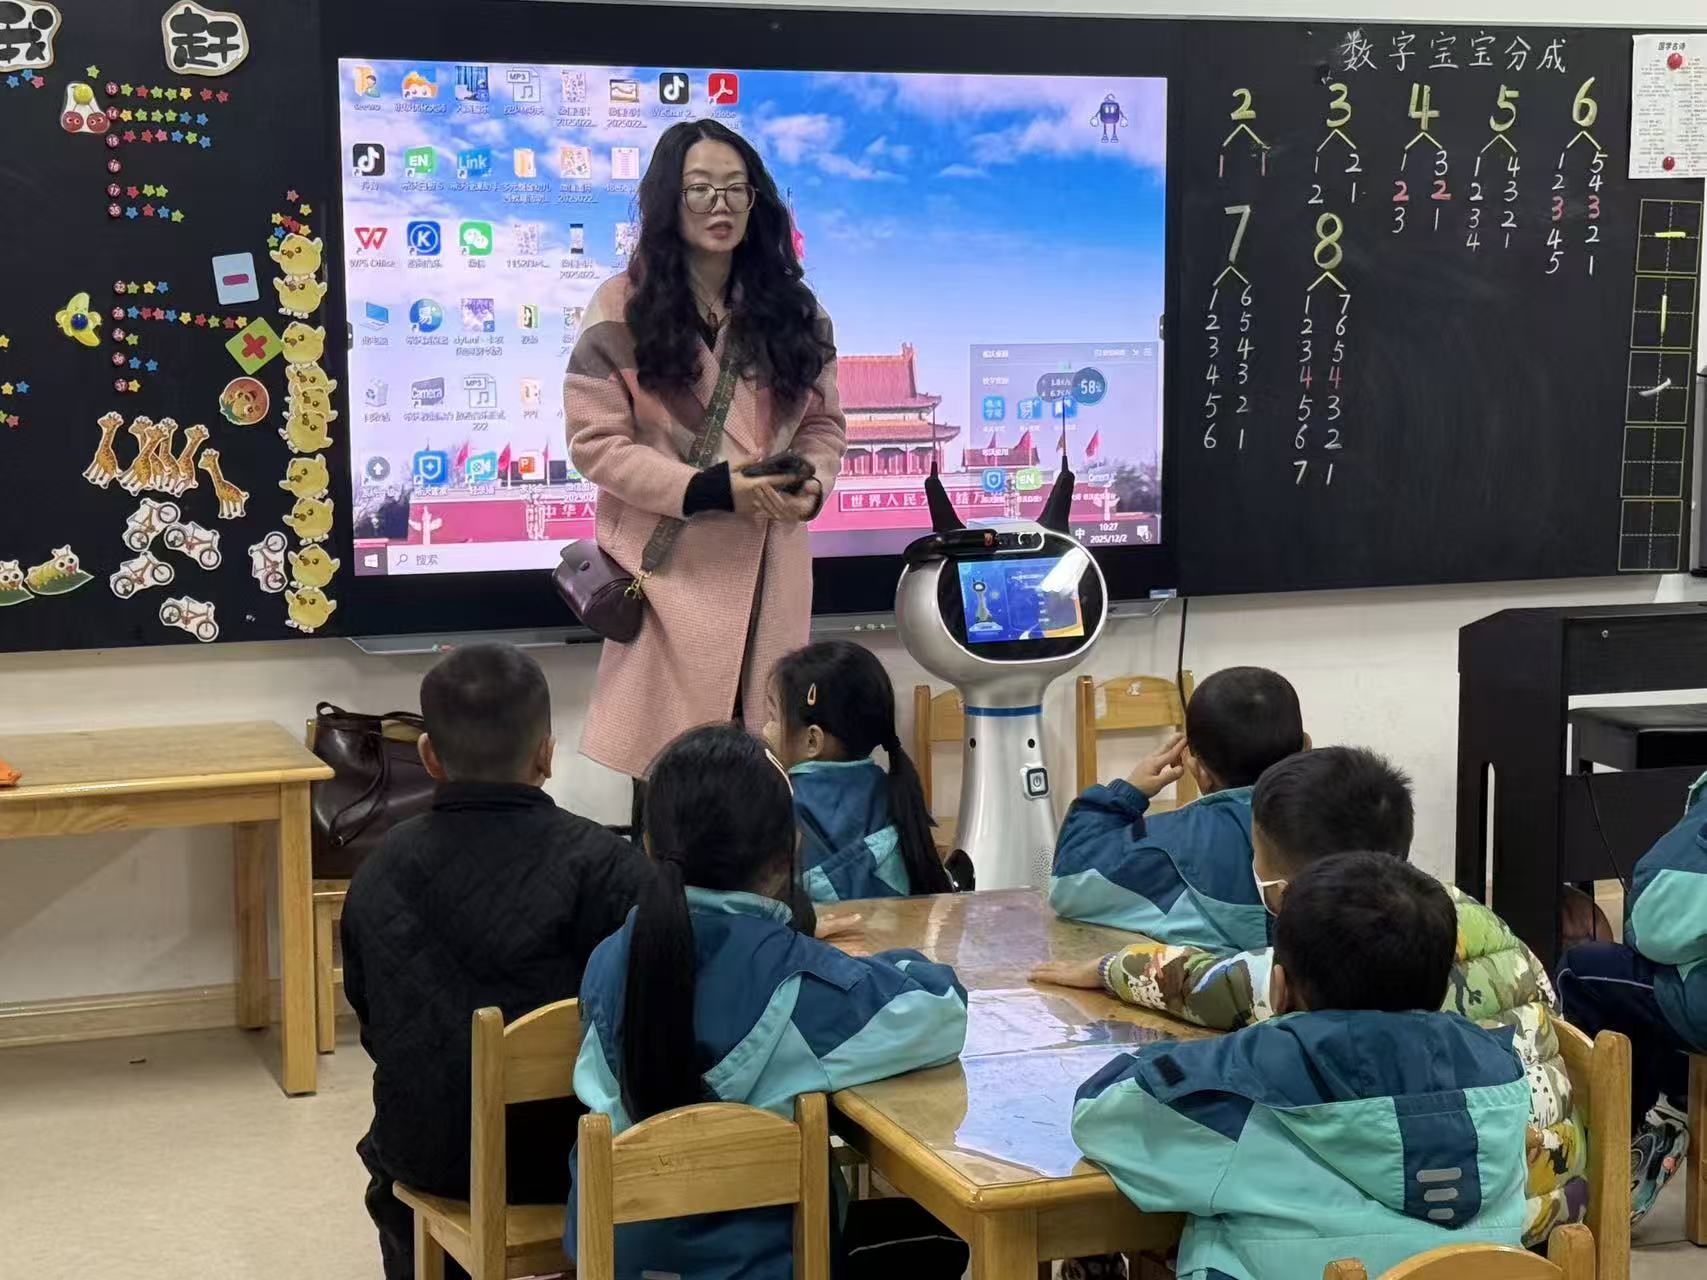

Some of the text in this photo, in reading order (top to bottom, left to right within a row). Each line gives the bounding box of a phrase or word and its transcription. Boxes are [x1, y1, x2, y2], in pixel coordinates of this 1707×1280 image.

[1339, 28, 1568, 75] 数字宝宝分成
[1230, 87, 1257, 121] 2
[1326, 82, 1352, 128] 3
[1407, 82, 1440, 131] 4
[1489, 83, 1520, 132] 5
[1572, 76, 1598, 127] 6
[409, 154, 429, 167] EN
[458, 154, 487, 169] Link
[1344, 153, 1363, 173] 2
[1434, 149, 1449, 177] 3
[1507, 155, 1521, 178] 4
[1589, 150, 1609, 174] 5
[1307, 183, 1325, 205] 2
[1392, 179, 1452, 202] 2 2
[1469, 180, 1519, 202] 2 3
[1551, 173, 1604, 193] 2 4
[1468, 207, 1518, 229] 3 2
[1551, 194, 1601, 221] 3 3
[1391, 206, 1406, 234] 3
[1224, 204, 1251, 263] 7
[1313, 212, 1343, 270] 8
[1465, 232, 1481, 252] 4
[1546, 225, 1601, 250] 4 2
[1545, 250, 1565, 275] 5
[1240, 284, 1252, 307] 6
[1338, 293, 1351, 315] 7
[1205, 311, 1252, 332] 2 5
[1300, 314, 1348, 336] 2 6
[1208, 336, 1254, 360] 3 4
[1299, 339, 1345, 363] 3 5
[1206, 362, 1249, 386] 4 3
[1299, 365, 1342, 390] 4 4
[411, 388, 444, 400] Camera
[1205, 392, 1249, 419] 5 2
[1298, 394, 1341, 422] 5 3
[1203, 422, 1217, 449] 6
[1294, 423, 1343, 450] 6 2
[1293, 459, 1308, 485] 7
[1075, 528, 1086, 540] 中
